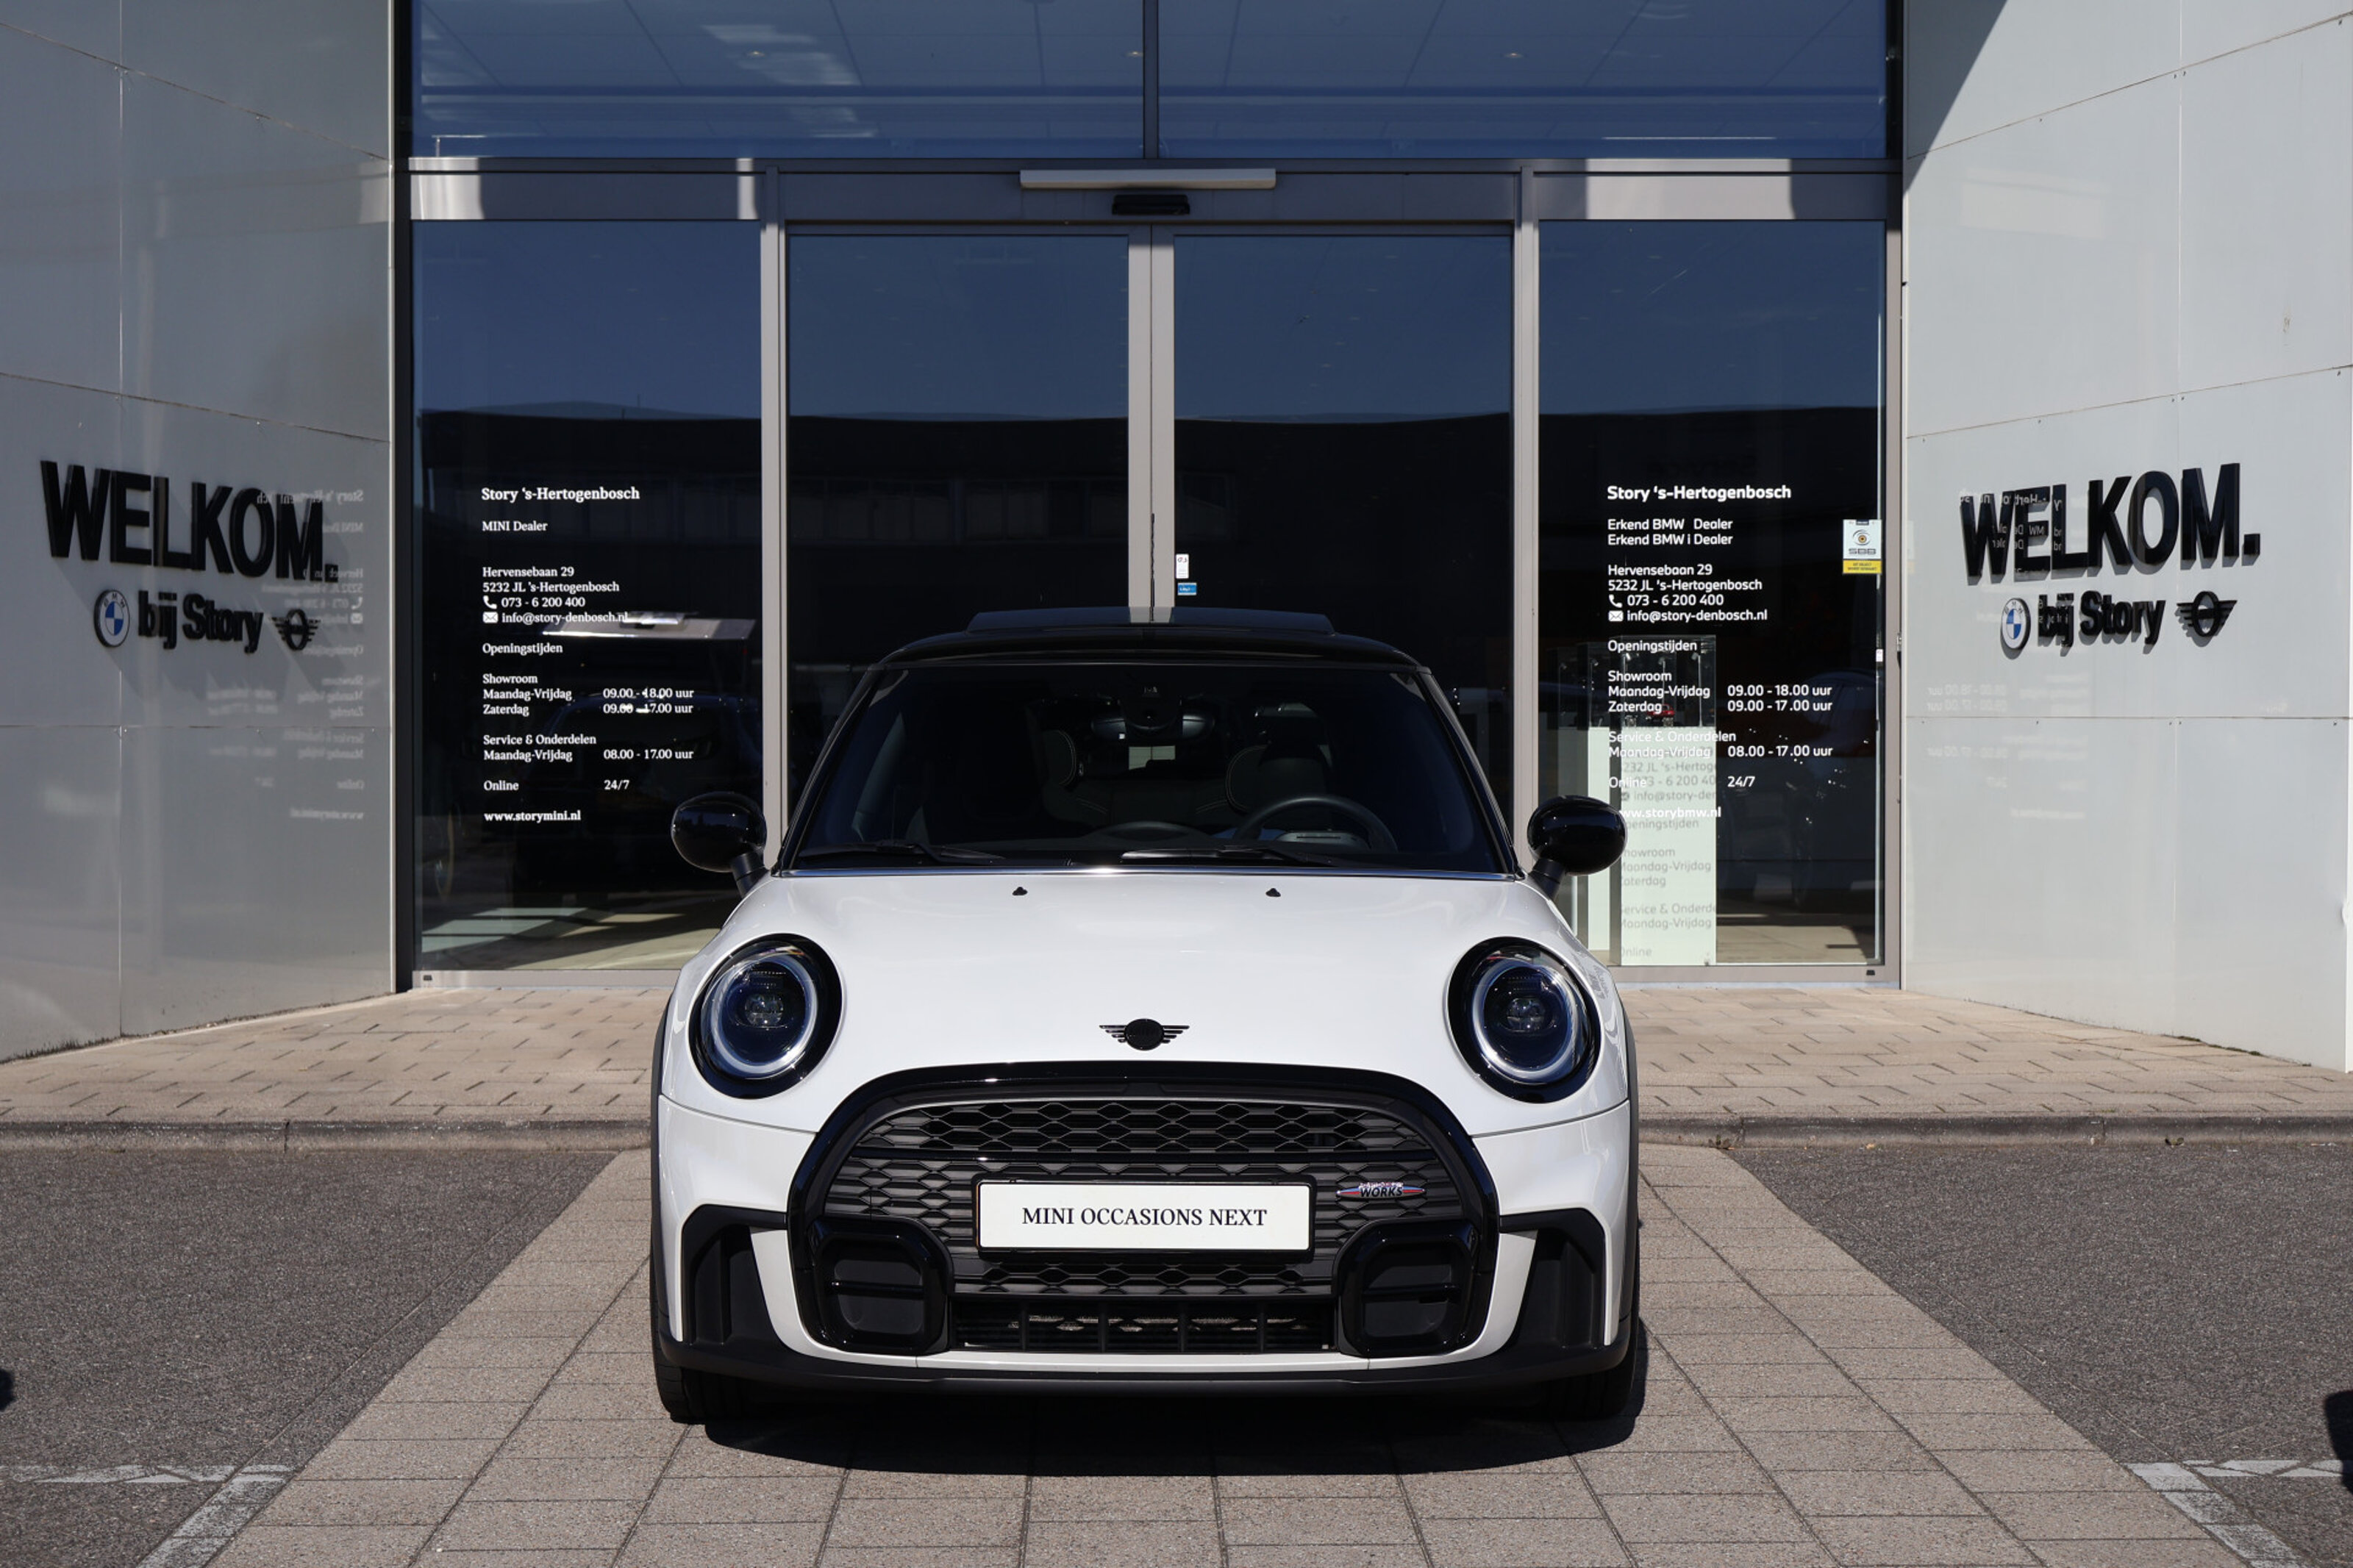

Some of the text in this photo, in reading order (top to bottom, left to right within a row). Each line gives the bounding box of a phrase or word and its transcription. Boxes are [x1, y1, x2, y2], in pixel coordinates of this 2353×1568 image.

[481, 487, 519, 504] Story
[1607, 485, 1651, 503] Story
[40, 459, 339, 583] WELKOM.
[482, 520, 549, 531] MINI Dealer
[1607, 518, 1733, 530] Erkend BMW Dealer
[1960, 463, 2260, 577] WELKOM.
[1607, 533, 1733, 545] Erkend BMW i Dealer
[482, 566, 574, 578] Hervensebaan 29
[1608, 563, 1713, 576] Hervensebaan 29
[482, 581, 510, 593] 5232
[513, 581, 526, 594] JL
[1608, 579, 1638, 591] 5232
[1640, 579, 1654, 593] JL
[501, 597, 522, 608] 073
[532, 597, 539, 607] 6
[542, 597, 563, 607] 200
[565, 596, 586, 607] 400
[1627, 594, 1649, 606] 073
[1661, 594, 1670, 606] 6
[1672, 593, 1697, 606] 200
[1699, 593, 1724, 606] 400
[138, 590, 263, 654] bij Story
[501, 612, 628, 625] info@story-denbosch.nl
[1627, 609, 1768, 623] info@story-denbosch.nl
[2038, 590, 2165, 645] bij Story
[482, 642, 563, 656] Openingstijden
[1607, 639, 1697, 654] Openingstijden
[482, 673, 538, 684] Showroom
[1607, 670, 1672, 682] Showroom
[483, 687, 572, 703] Maandag-Vrijdag
[602, 687, 634, 699] 09.00
[644, 687, 673, 699] 18.00
[675, 690, 695, 698] uur
[1608, 685, 1710, 699] Maandag-Vrijdag
[1727, 684, 1764, 697] 09.00
[1775, 684, 1810, 696] 18.00
[1812, 687, 1832, 696] uur
[483, 704, 529, 717] Zaterdag
[644, 703, 672, 714] 17.00
[674, 705, 693, 714] uur
[1608, 701, 1663, 715] Zaterdag
[1727, 699, 1764, 712] 09.00
[1813, 702, 1833, 712] uur
[483, 733, 596, 745] Service & Onderdelen
[1608, 731, 1736, 742] Service & Onderdelen
[484, 749, 573, 763] Maandag-Vrijdag
[603, 749, 635, 759] 08.00
[644, 748, 673, 759] 17.00
[674, 751, 694, 759] uur
[1608, 746, 1711, 759] Maandag-Vrijdag
[1727, 745, 1765, 758] 08.00
[1813, 748, 1833, 757] uur
[1622, 762, 1643, 773] 232
[483, 779, 629, 791] Online 24/7
[1608, 776, 1756, 788] Online 24/7
[484, 809, 582, 823] www.storymini.nl
[1618, 806, 1721, 820] ww.storybmw.nl
[1360, 1186, 1404, 1198] WORKS
[1022, 1207, 1268, 1226] MINI OCCASIONS NEXT
